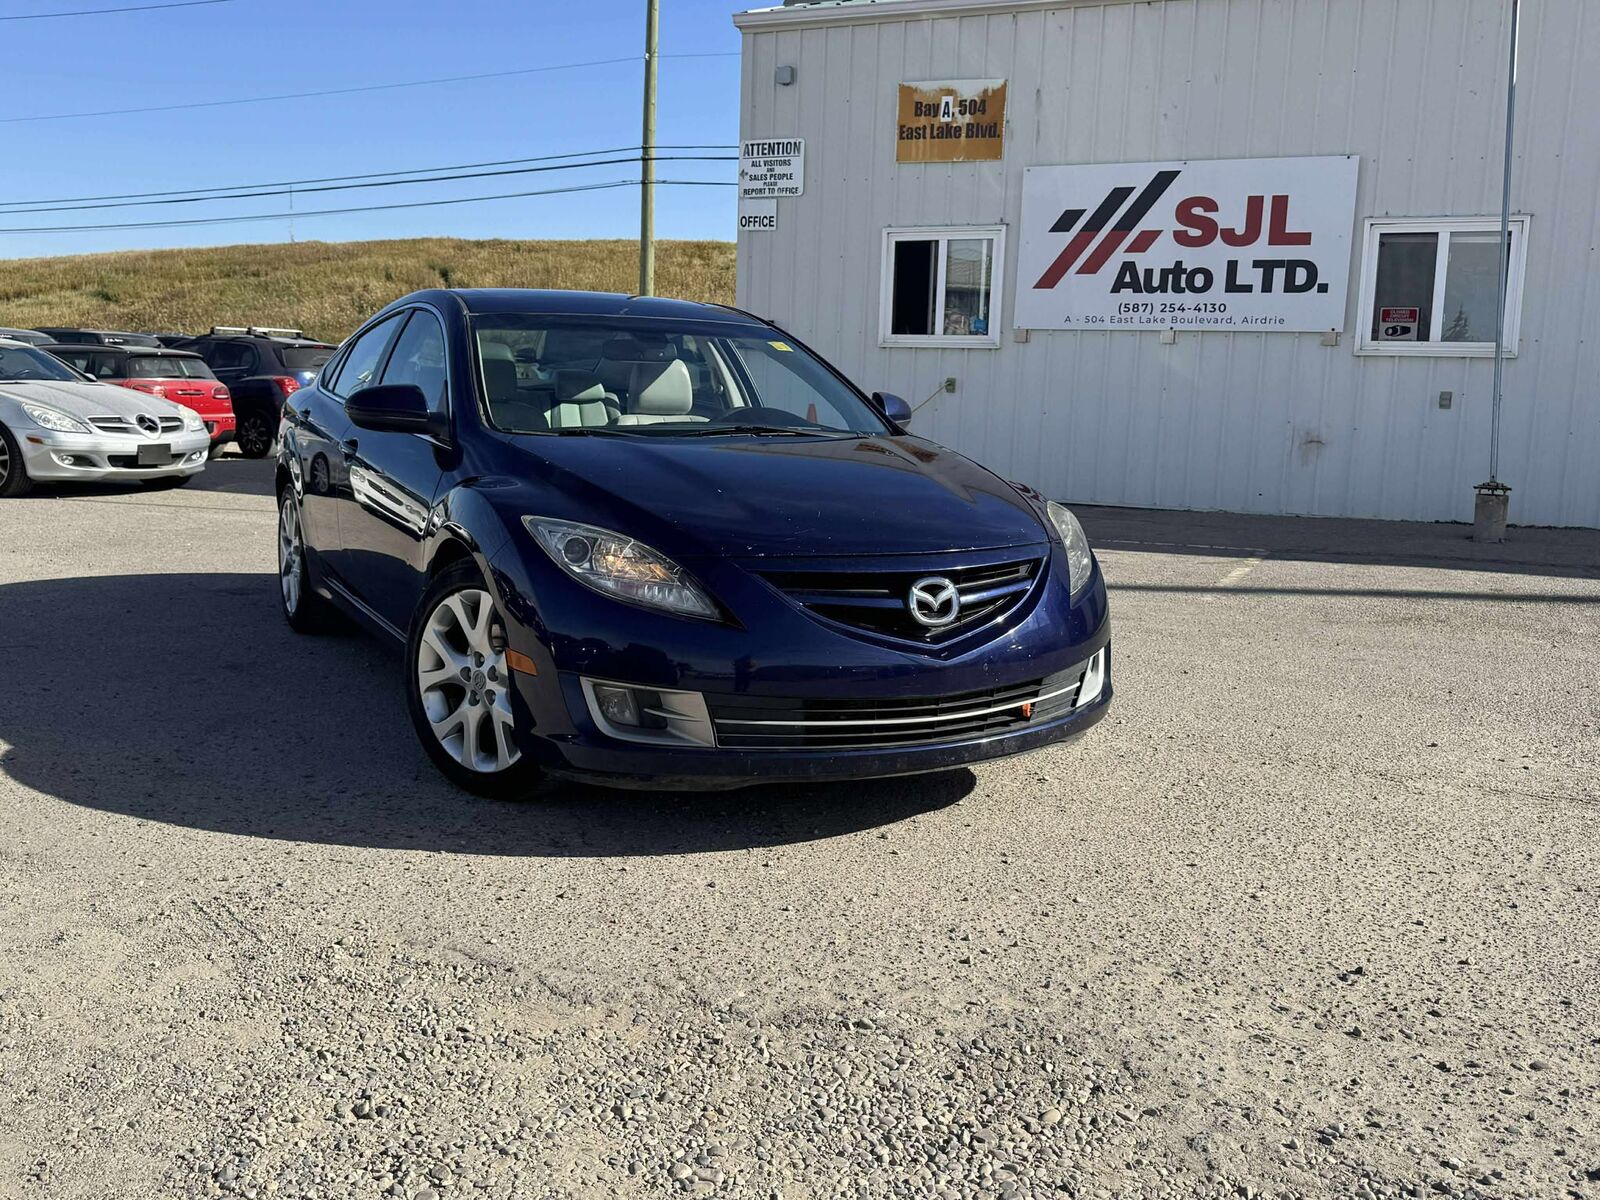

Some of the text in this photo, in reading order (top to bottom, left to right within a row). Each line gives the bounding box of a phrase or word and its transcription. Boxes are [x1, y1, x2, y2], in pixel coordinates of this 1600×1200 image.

[914, 101, 940, 118] Bay
[958, 99, 987, 116] 504
[899, 122, 1001, 141] East Lake Blvd.
[743, 141, 801, 156] ATTENTION
[763, 159, 792, 167] VISITORS
[748, 172, 794, 181] SALES PEOPLE
[743, 188, 766, 196] REPORT
[777, 187, 799, 195] OFFICE
[740, 215, 775, 228] OFFICE
[1172, 194, 1313, 248] SJL
[1109, 259, 1329, 294] Auto LTD.
[1118, 302, 1227, 315] (587) 254-4130
[1063, 315, 1072, 324] A
[1084, 315, 1105, 324] 504
[1109, 315, 1134, 324] East
[1139, 315, 1166, 324] Lake
[1170, 315, 1236, 325] Boulevard,
[1241, 315, 1285, 325] Airdrie
